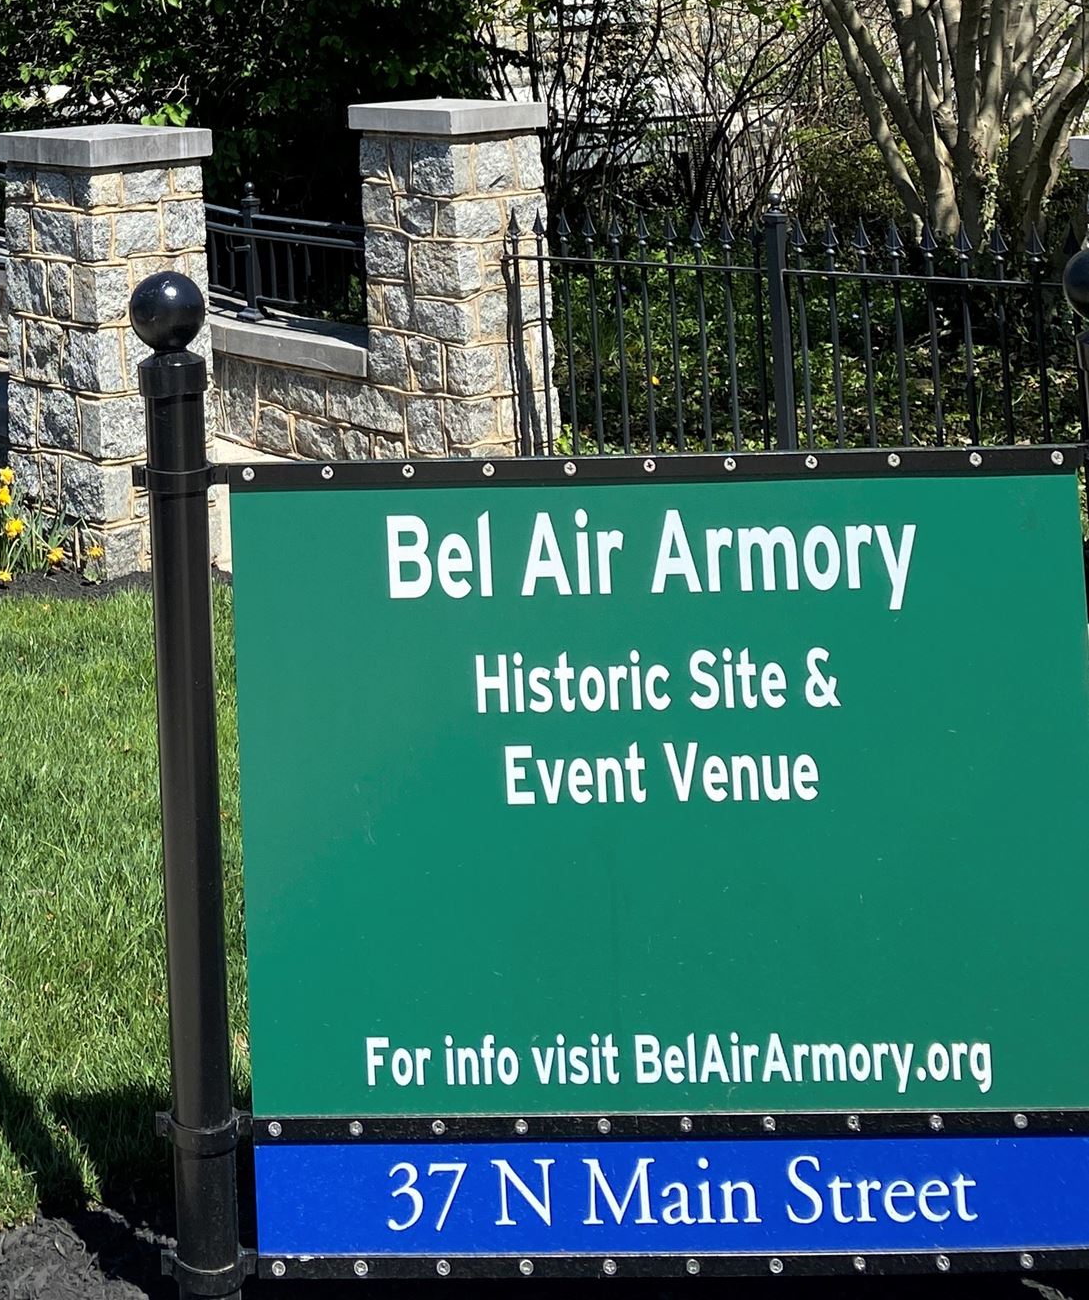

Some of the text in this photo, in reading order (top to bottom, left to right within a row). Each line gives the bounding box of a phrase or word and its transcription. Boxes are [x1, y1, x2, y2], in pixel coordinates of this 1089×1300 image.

[385, 507, 918, 611] Bel Air Armory
[474, 646, 843, 715] Historic Site &
[503, 740, 820, 806] Event Venue
[365, 1031, 993, 1094] For info visit BelAirArmory.org
[387, 1154, 979, 1232] 37 N Main Street
